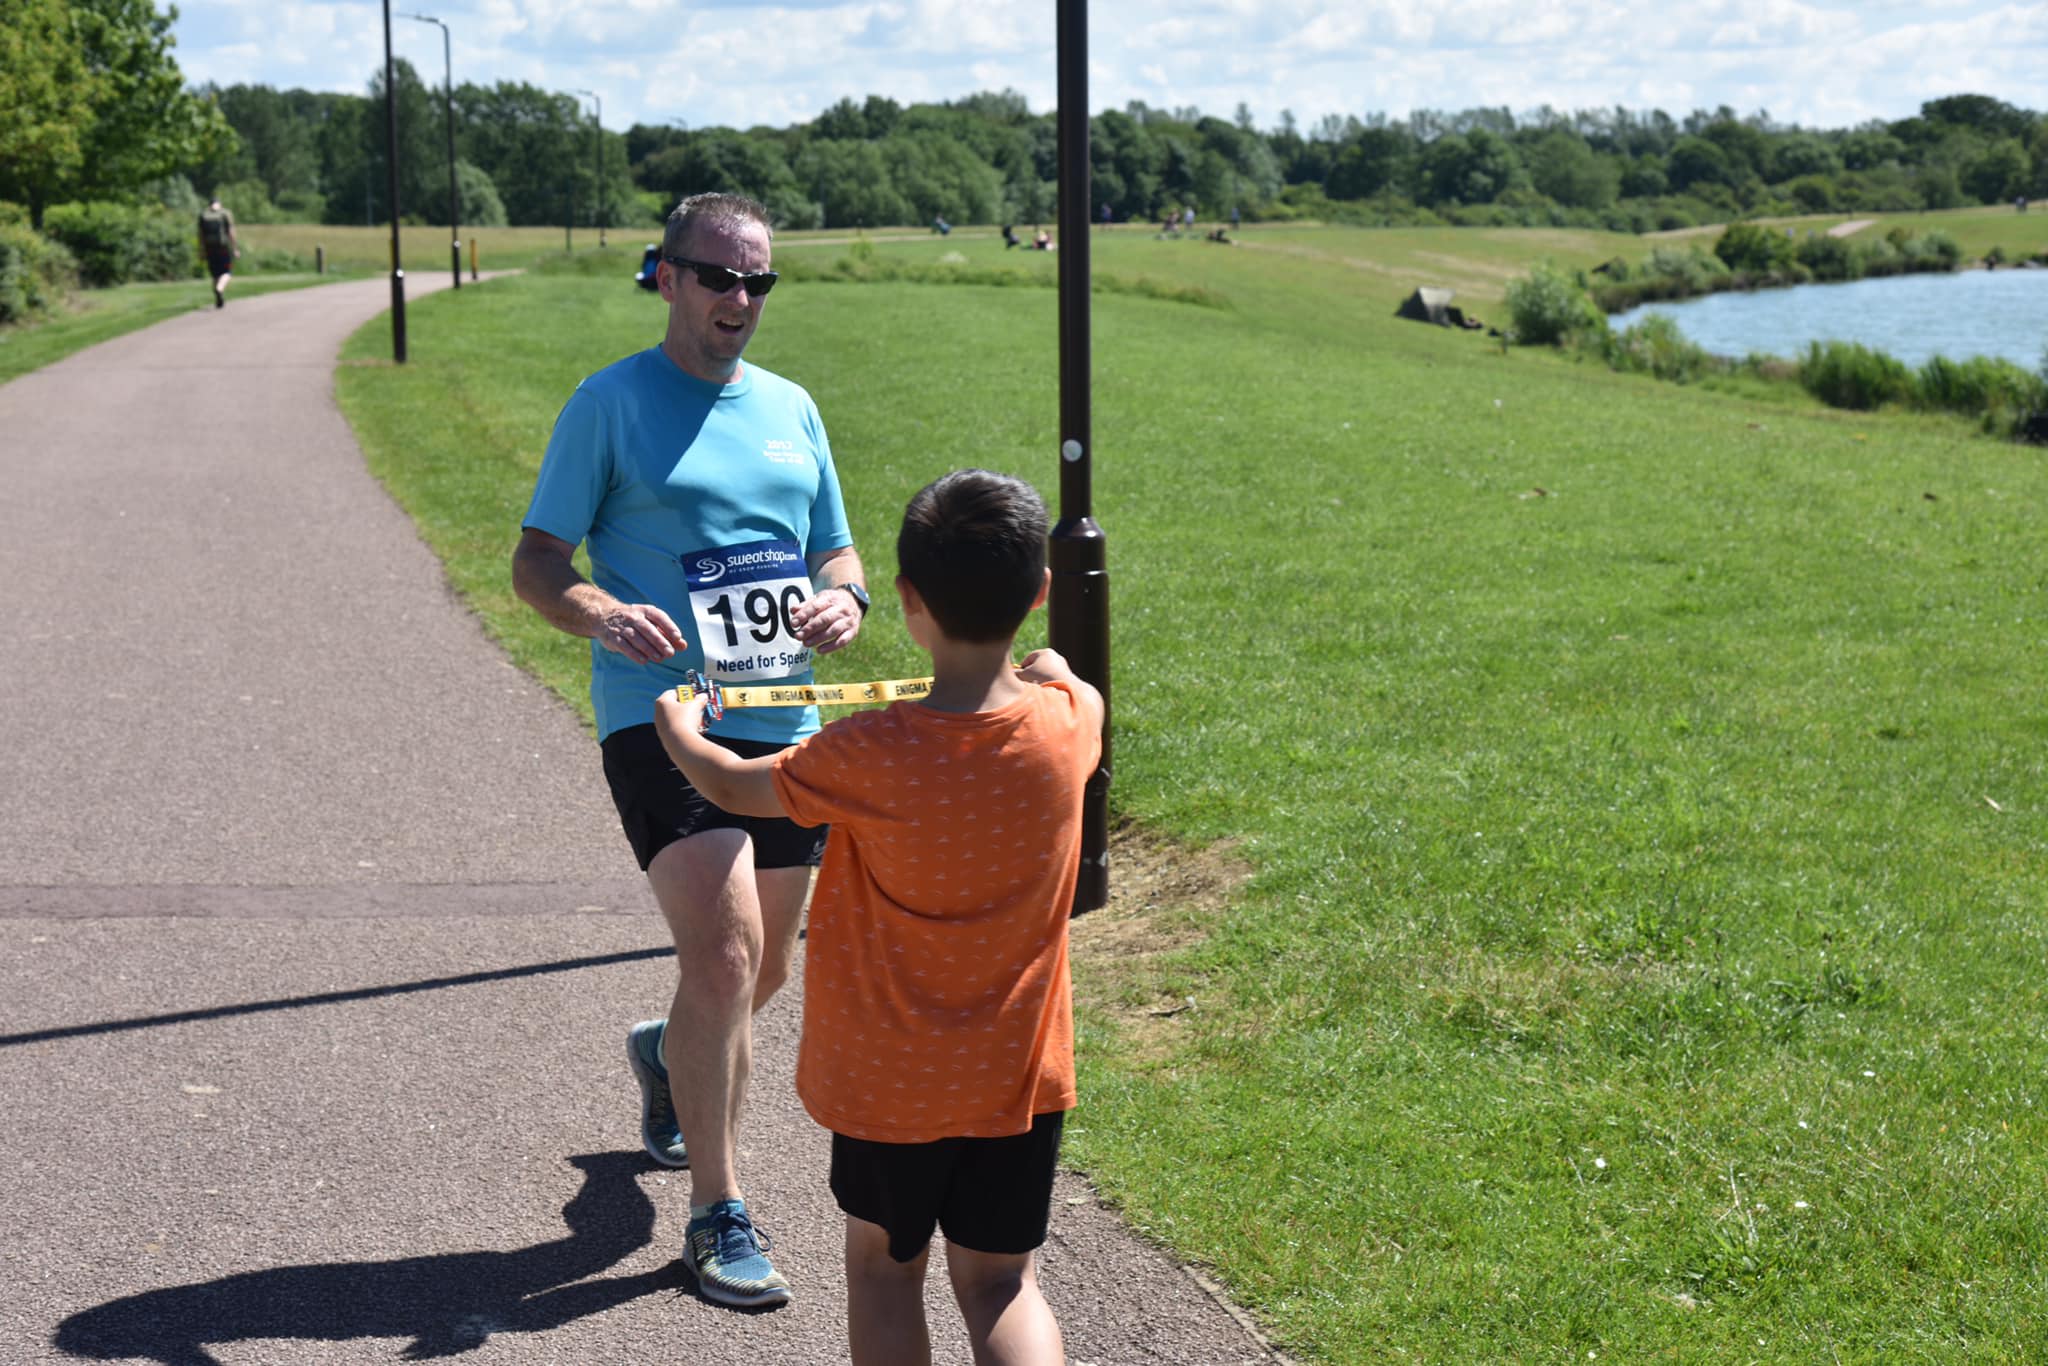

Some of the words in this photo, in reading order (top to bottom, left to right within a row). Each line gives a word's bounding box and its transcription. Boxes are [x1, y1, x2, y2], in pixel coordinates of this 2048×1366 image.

[707, 584, 806, 647] 190
[716, 655, 754, 673] Need
[757, 655, 777, 669] for
[770, 690, 804, 702] ENIGMA
[895, 682, 928, 696] ENIGMA
